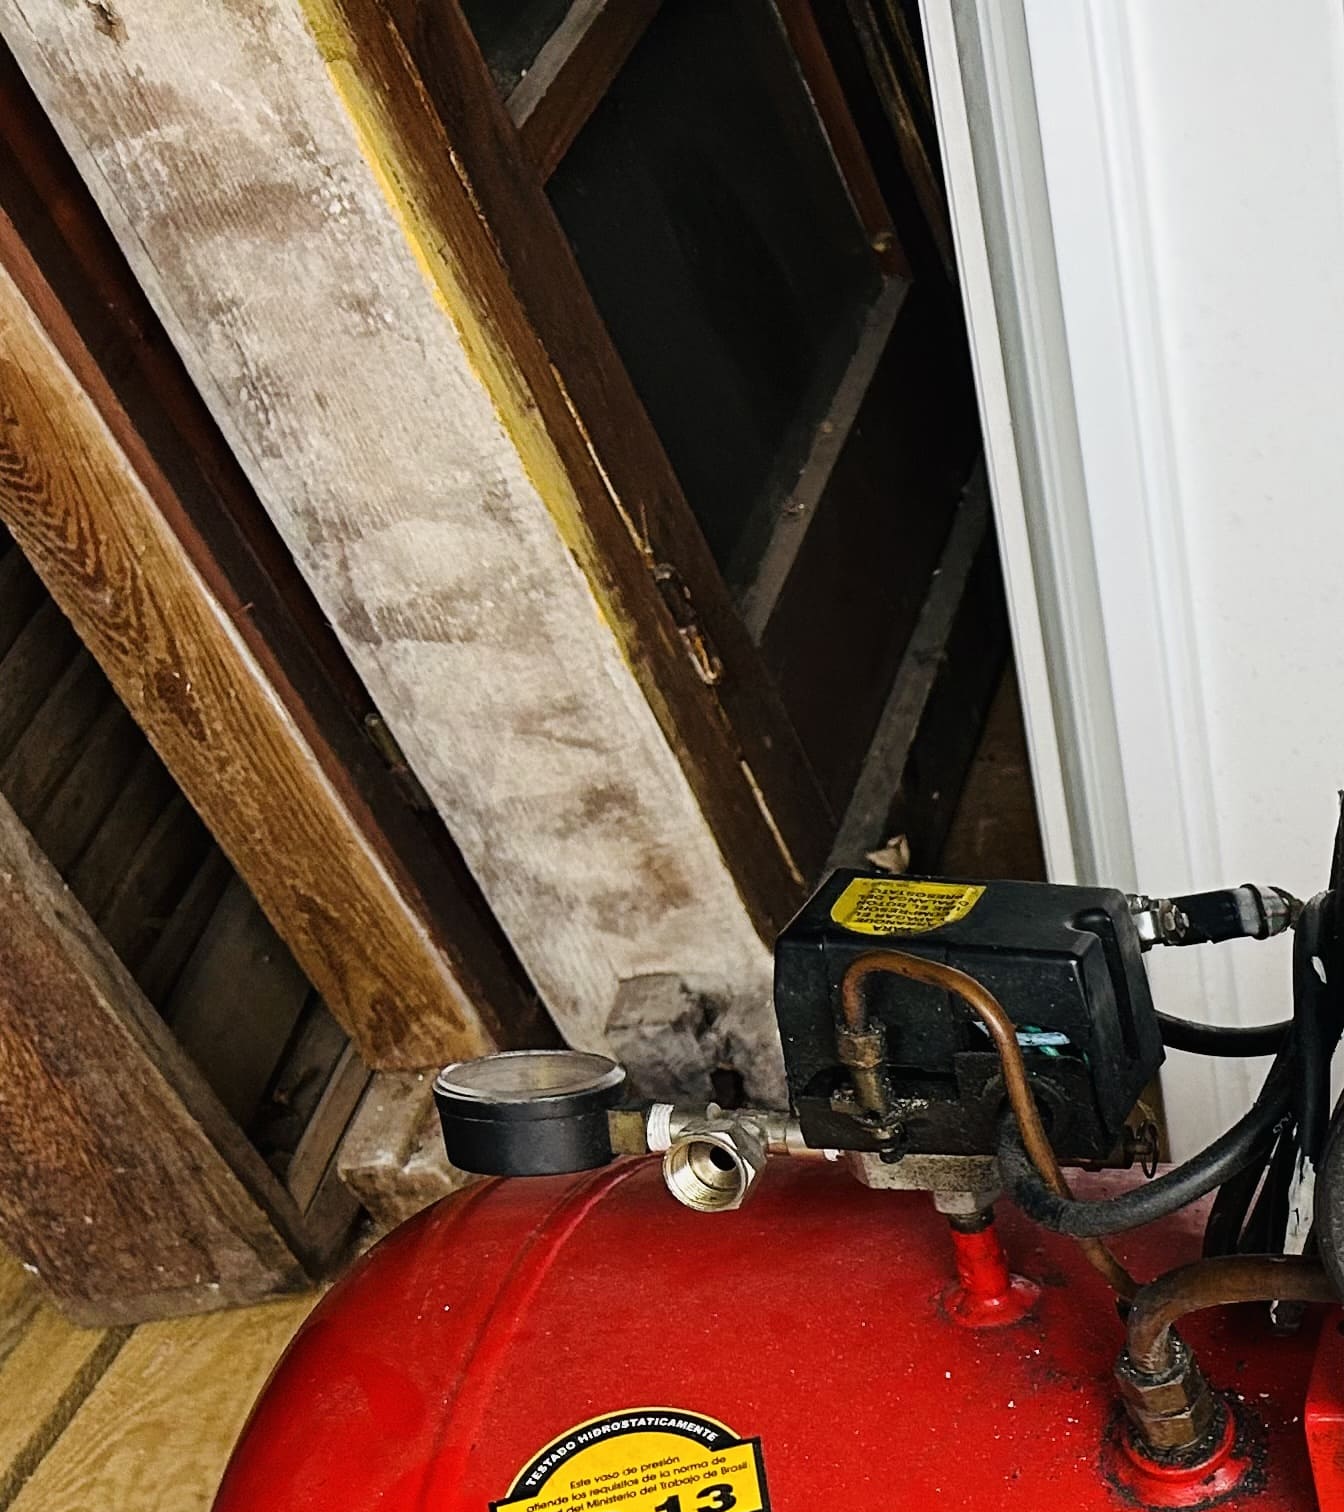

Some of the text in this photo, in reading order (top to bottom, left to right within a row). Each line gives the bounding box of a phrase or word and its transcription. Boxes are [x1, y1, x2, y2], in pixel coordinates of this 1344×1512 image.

[525, 1417, 720, 1486] TESTADO HIDROSTATICAMENTE
[570, 1456, 680, 1490] Este vaso de presión
[571, 1489, 587, 1502] los
[590, 1478, 640, 1498] requisitos
[641, 1472, 657, 1483] de
[660, 1470, 671, 1479] la
[673, 1460, 709, 1475] norma
[711, 1456, 727, 1466] de
[586, 1490, 637, 1510] Ministerio
[640, 1483, 658, 1496] del
[660, 1474, 701, 1491] Trabajo
[702, 1468, 718, 1479] de
[720, 1461, 748, 1475] Brasil
